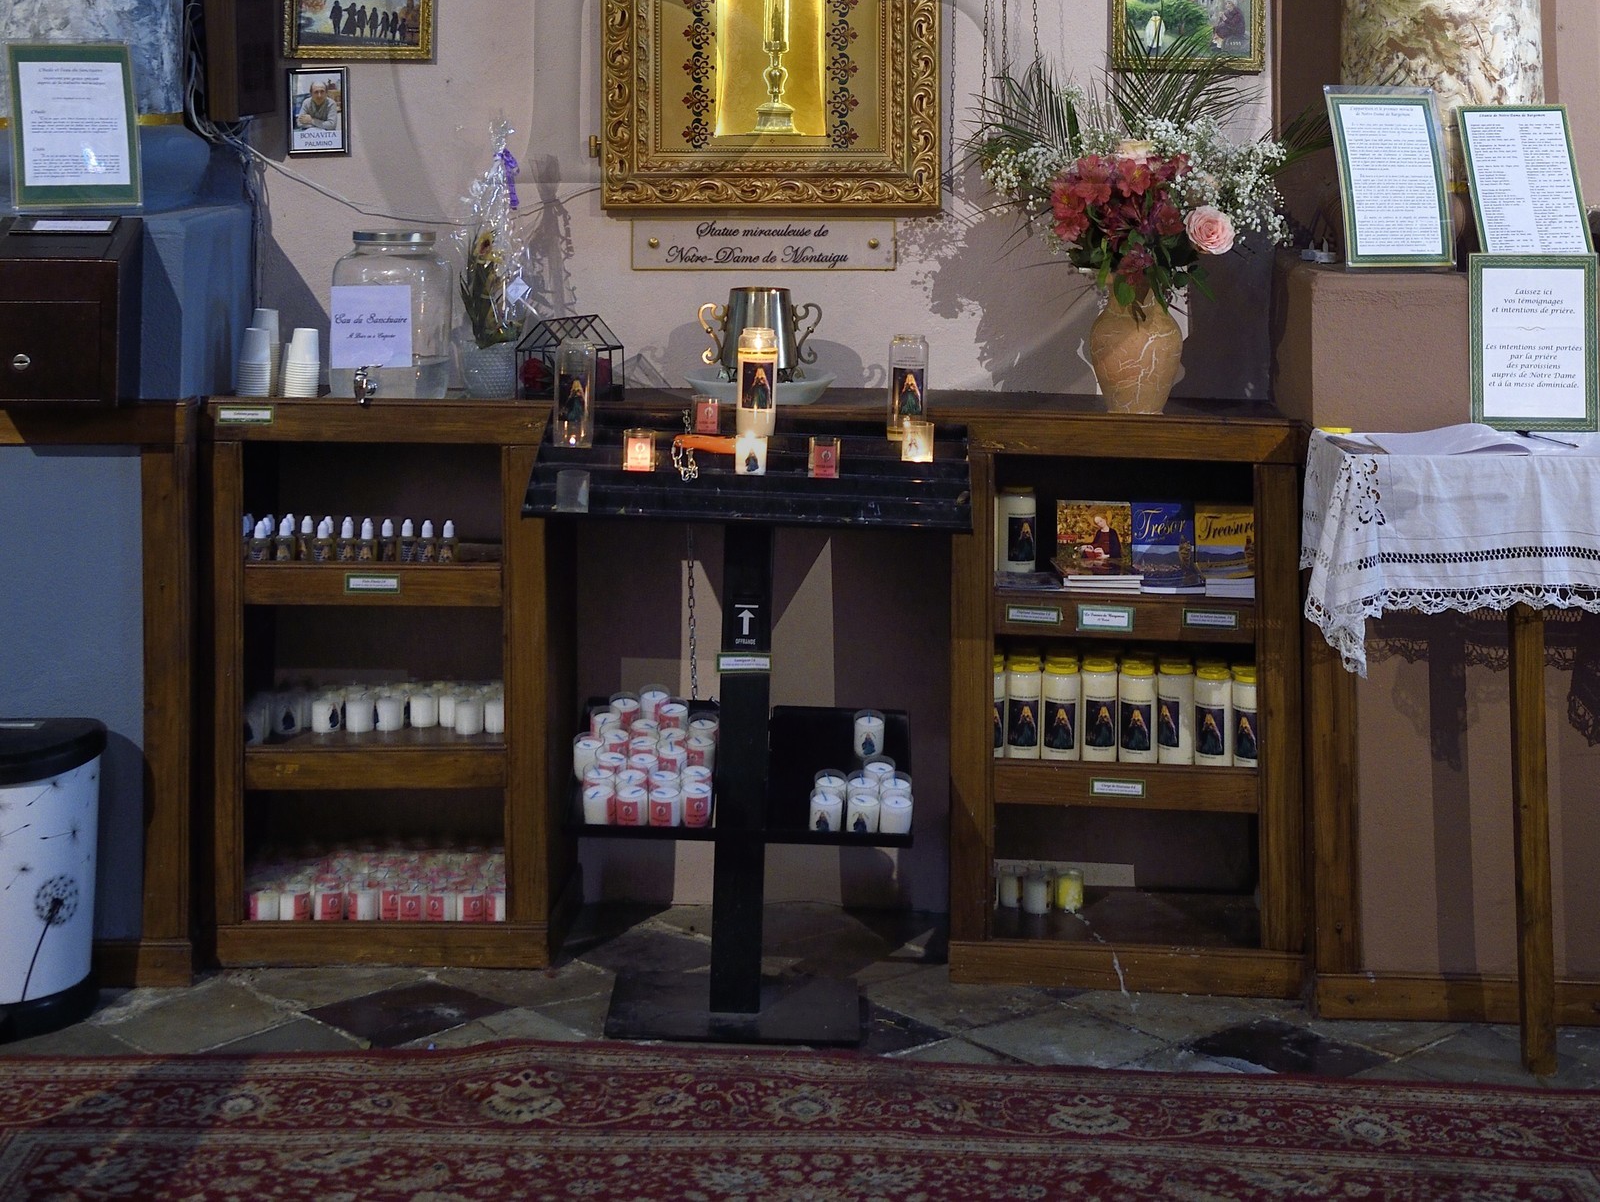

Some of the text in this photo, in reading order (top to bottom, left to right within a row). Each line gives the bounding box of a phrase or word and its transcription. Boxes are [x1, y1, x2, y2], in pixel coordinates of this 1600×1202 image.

[696, 221, 829, 238] Statue miraculeuse de
[665, 245, 848, 268] Notre-Dame de Montaigu
[1518, 297, 1564, 306] témoignages
[334, 313, 408, 324] Eau du Sanctuaire
[1555, 343, 1582, 352] portées
[1534, 353, 1557, 361] prière
[1506, 361, 1561, 370] des paroissiens
[1529, 371, 1552, 379] Notre
[1536, 380, 1579, 389] dominicale.
[1134, 508, 1186, 539] Trésor
